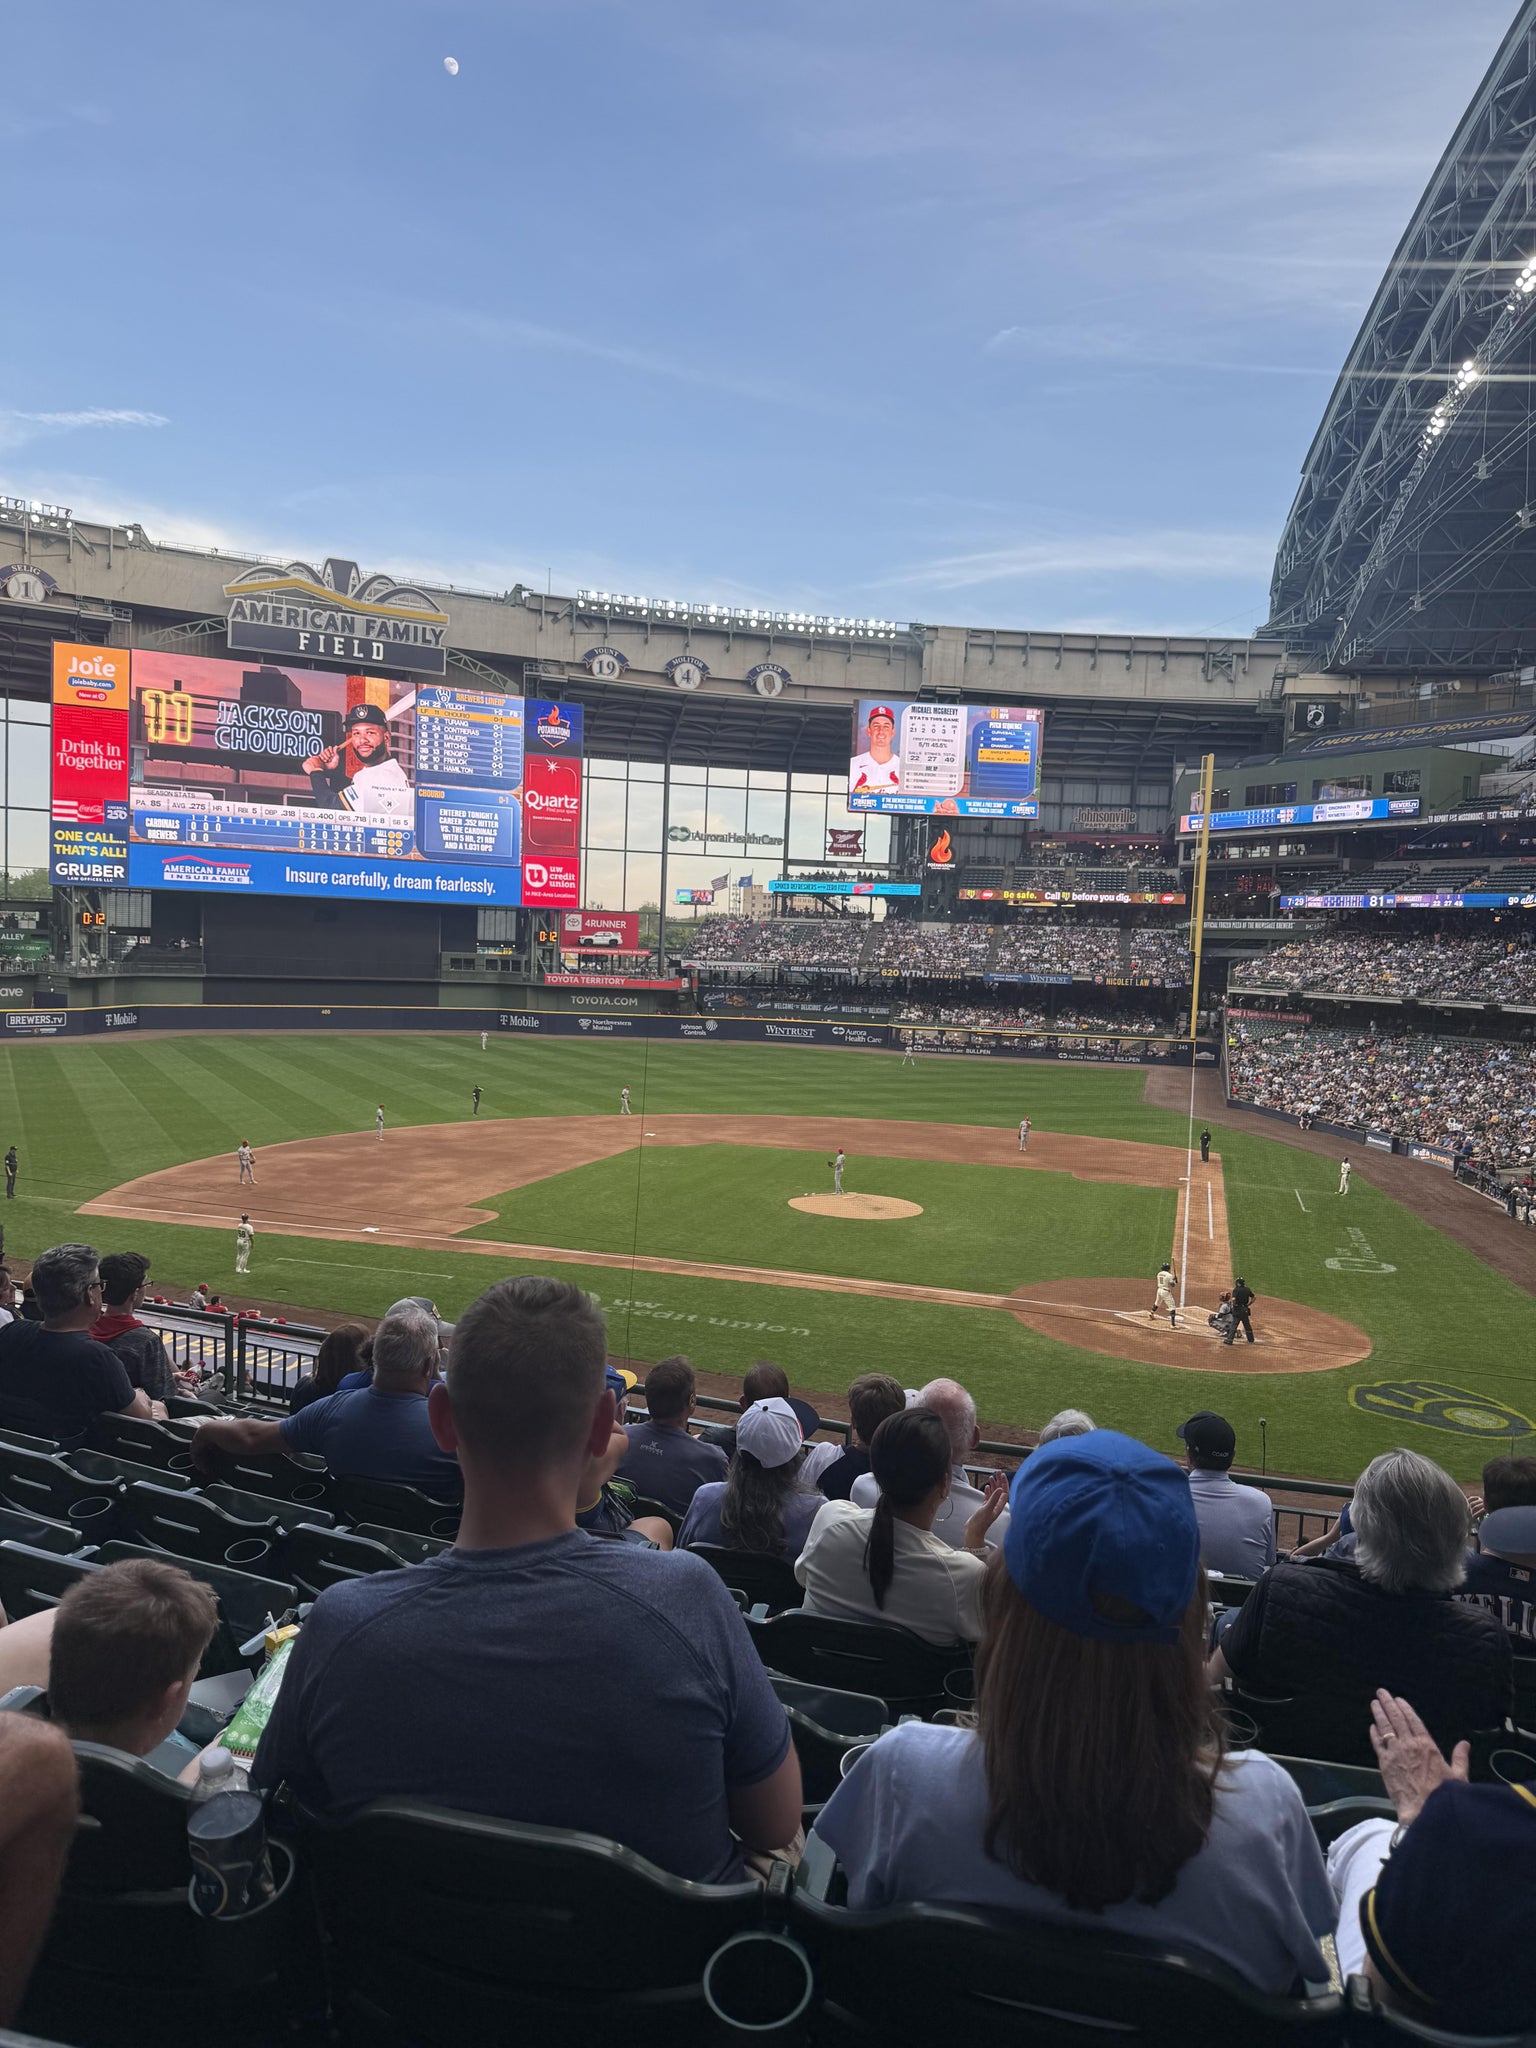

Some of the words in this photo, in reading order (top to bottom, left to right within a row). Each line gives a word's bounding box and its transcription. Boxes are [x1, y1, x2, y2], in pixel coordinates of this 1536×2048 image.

[11, 564, 41, 576] SELIG
[22, 581, 33, 600] 1
[231, 599, 355, 634] AMERICAN
[365, 619, 445, 646] FAMILY
[299, 632, 384, 661] FIELD
[594, 648, 619, 657] YOUNT
[67, 656, 116, 677] Joie
[596, 660, 615, 676] 19
[672, 656, 704, 669] MOLITOR
[756, 664, 783, 674] UECKER
[681, 669, 691, 683] 4
[456, 693, 484, 704] BREWERS
[485, 697, 506, 706] LINEUP
[144, 689, 192, 743] 11
[911, 706, 932, 714] MICHAEL
[933, 707, 958, 716] MCGREEVY
[217, 701, 322, 736] JACKSON
[444, 726, 479, 736] CONTRERAS
[1322, 736, 1362, 746] MUST
[1428, 721, 1483, 732] FRONT
[215, 725, 324, 757] CHOURIO
[444, 742, 472, 750] MITCHELL
[62, 739, 103, 755] Drink
[107, 743, 120, 757] in
[57, 752, 125, 771] Together
[443, 766, 473, 774] HAMILTON
[147, 789, 172, 797] SEASON
[418, 789, 445, 798] CHOURIO
[525, 790, 578, 810] Quartz
[107, 810, 128, 820] 250
[316, 812, 334, 820] .400
[440, 809, 466, 817] ENTERED
[467, 811, 493, 820] TONIGHT
[1074, 808, 1136, 824] Johnsonville
[145, 817, 180, 829] CARDINALS
[439, 817, 462, 825] CAREER
[478, 820, 499, 828] HITTER
[54, 830, 83, 841] ONE
[85, 832, 126, 844] CALL...
[147, 829, 178, 840] BREWERS
[464, 827, 497, 836] CARDINALS
[484, 836, 495, 844] RBI
[695, 833, 724, 843] Aurora
[729, 833, 759, 844] Health
[762, 834, 783, 845] Care
[53, 844, 98, 856] THAT'S
[100, 847, 127, 858] ALL!
[445, 842, 457, 850] AND
[55, 862, 125, 878] GRUBER
[164, 864, 213, 874] AMERICAN
[216, 867, 249, 876] FAMILY
[550, 865, 563, 873] uw
[171, 874, 243, 882] INSURANCE
[285, 866, 328, 884] Insure
[331, 869, 390, 890] carefully,
[394, 873, 432, 891] dream
[435, 876, 496, 896] fearlessly.
[549, 873, 576, 881] credit
[550, 880, 576, 888] union
[1003, 891, 1014, 899] Be
[1016, 891, 1037, 899] safe.
[1045, 892, 1061, 900] Call
[1072, 893, 1099, 901] before
[1100, 894, 1114, 903] you
[1116, 893, 1131, 903] dig.
[1370, 896, 1383, 906] 81
[1508, 897, 1519, 905] go
[585, 920, 627, 929] 4RUNNER
[881, 969, 899, 977] 620
[900, 970, 929, 978] WTMJ
[547, 976, 579, 984] TOYOTA
[581, 976, 626, 985] TERRITORY
[1106, 978, 1133, 986] NICOLET
[1135, 978, 1149, 986] LAW
[571, 996, 638, 1006] TOYOTA.COM
[801, 1003, 821, 1011] DELICIOUS
[10, 1015, 62, 1025] BREWERS.TV
[113, 1013, 137, 1025] Mobile
[509, 1016, 539, 1027] Mobile
[592, 1018, 632, 1026] Northwestern
[765, 1025, 816, 1036] WINTRUST
[846, 1028, 867, 1036] Aurora
[845, 1035, 866, 1043] Health
[612, 1299, 663, 1309] uw
[601, 1306, 698, 1322] credit
[709, 1317, 811, 1336] union
